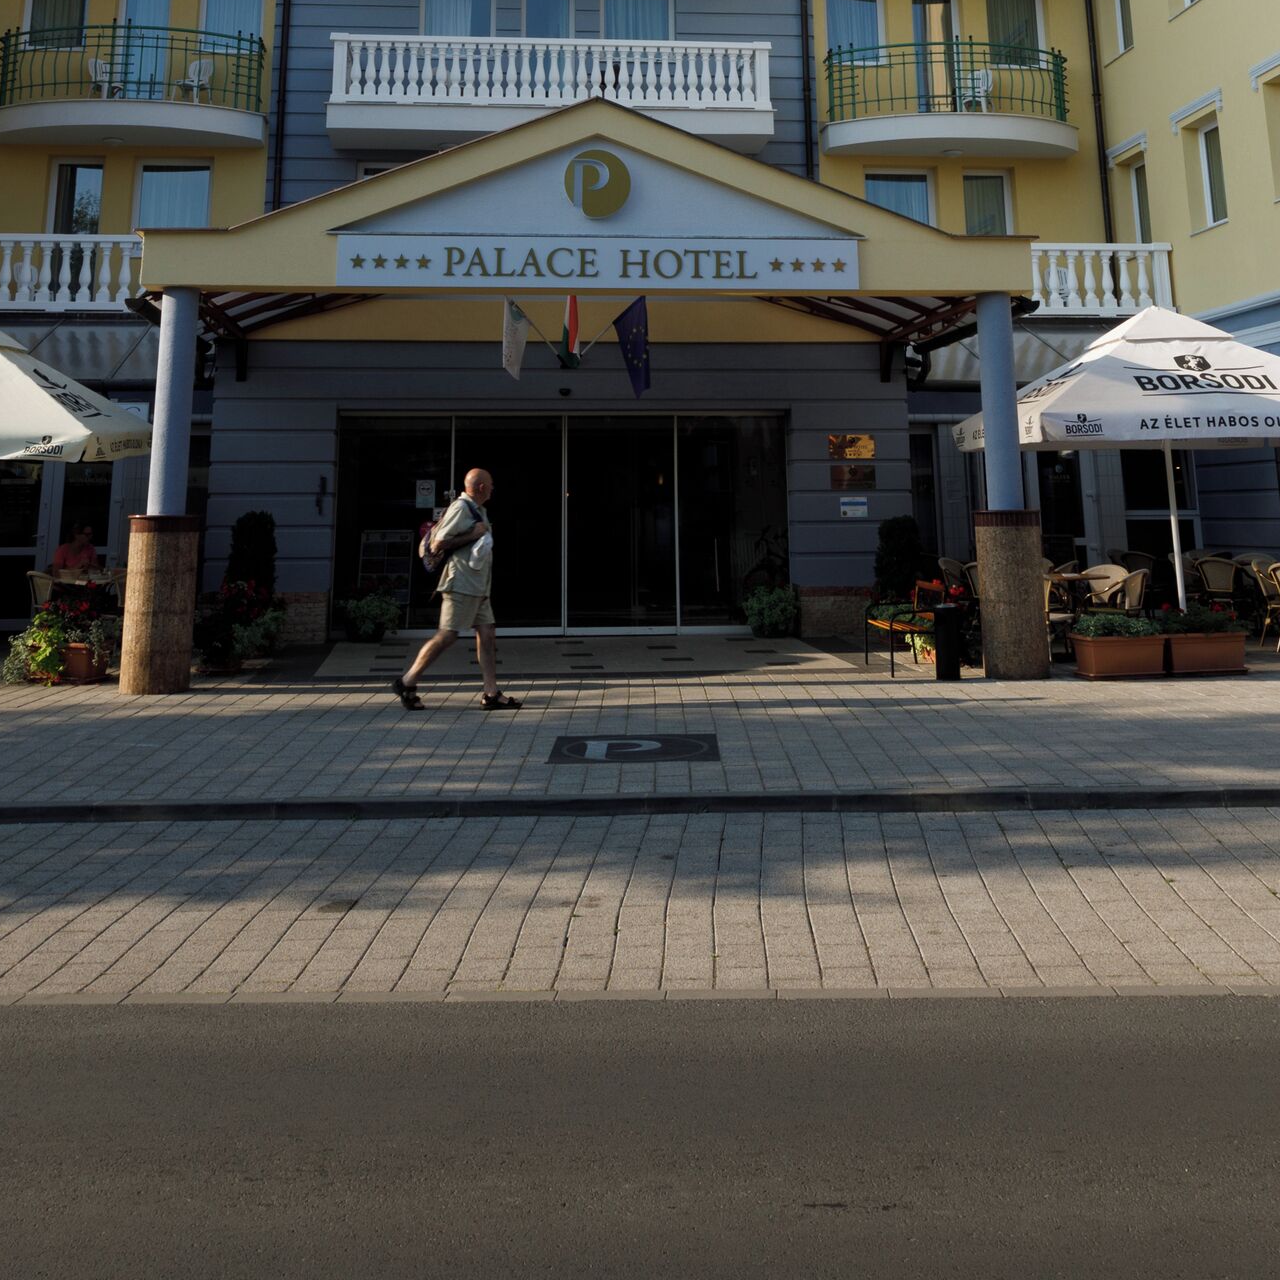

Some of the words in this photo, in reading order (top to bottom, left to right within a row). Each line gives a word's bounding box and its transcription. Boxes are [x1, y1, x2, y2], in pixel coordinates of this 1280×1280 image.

[573, 158, 610, 213] P
[443, 247, 599, 277] PALACE
[619, 249, 758, 280] HOTEL
[1133, 373, 1279, 391] BORSODI
[1066, 423, 1104, 435] BORSODI
[1140, 418, 1160, 430] AZ
[1165, 412, 1201, 430] ÉLET
[1207, 416, 1259, 429] HABOS
[24, 445, 64, 456] BORSODI
